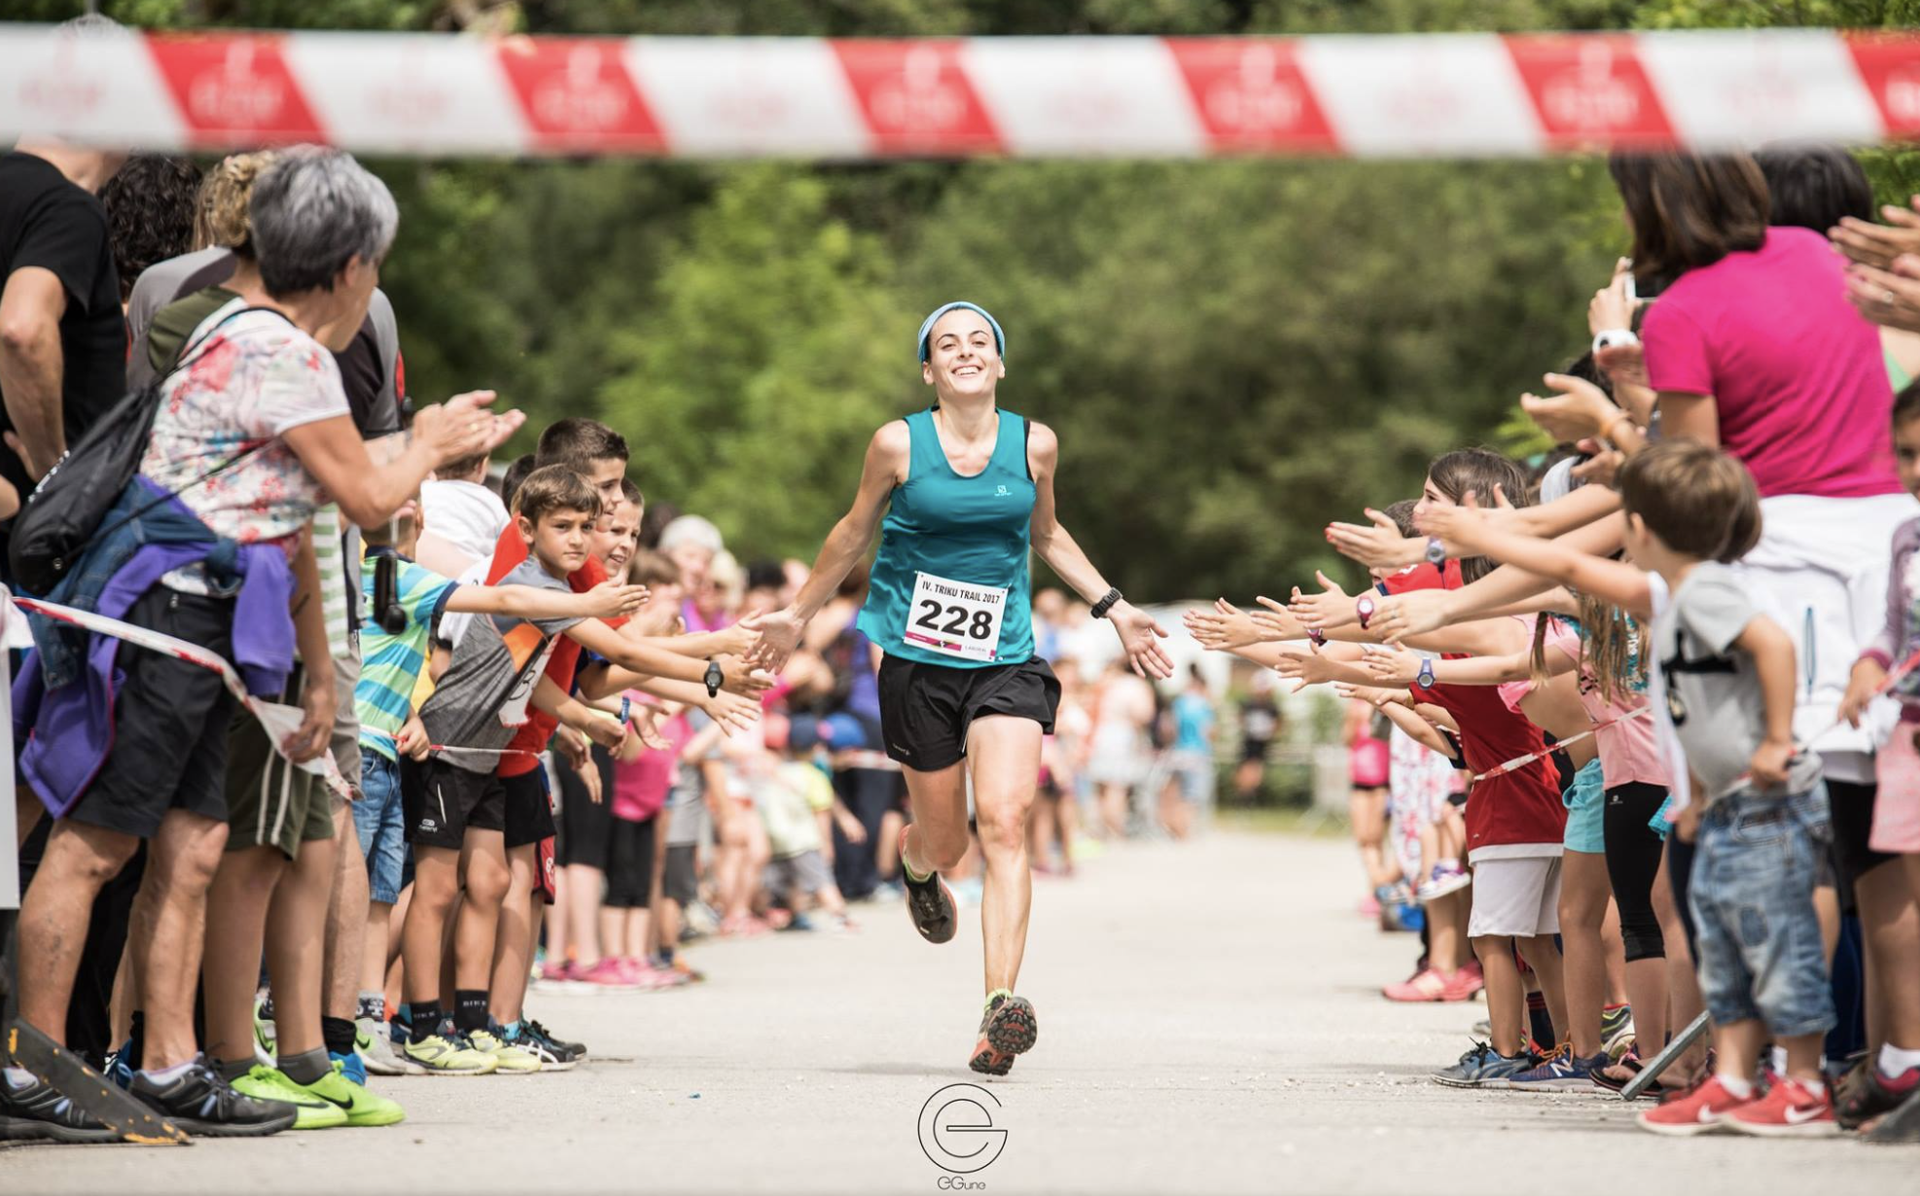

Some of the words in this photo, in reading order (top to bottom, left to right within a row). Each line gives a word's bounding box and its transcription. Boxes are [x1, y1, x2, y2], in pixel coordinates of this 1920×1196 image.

[922, 580, 933, 592] IV.
[935, 584, 958, 598] TRIKU
[960, 589, 981, 602] TRAIL
[983, 593, 1000, 604] 2017
[915, 599, 993, 640] 228
